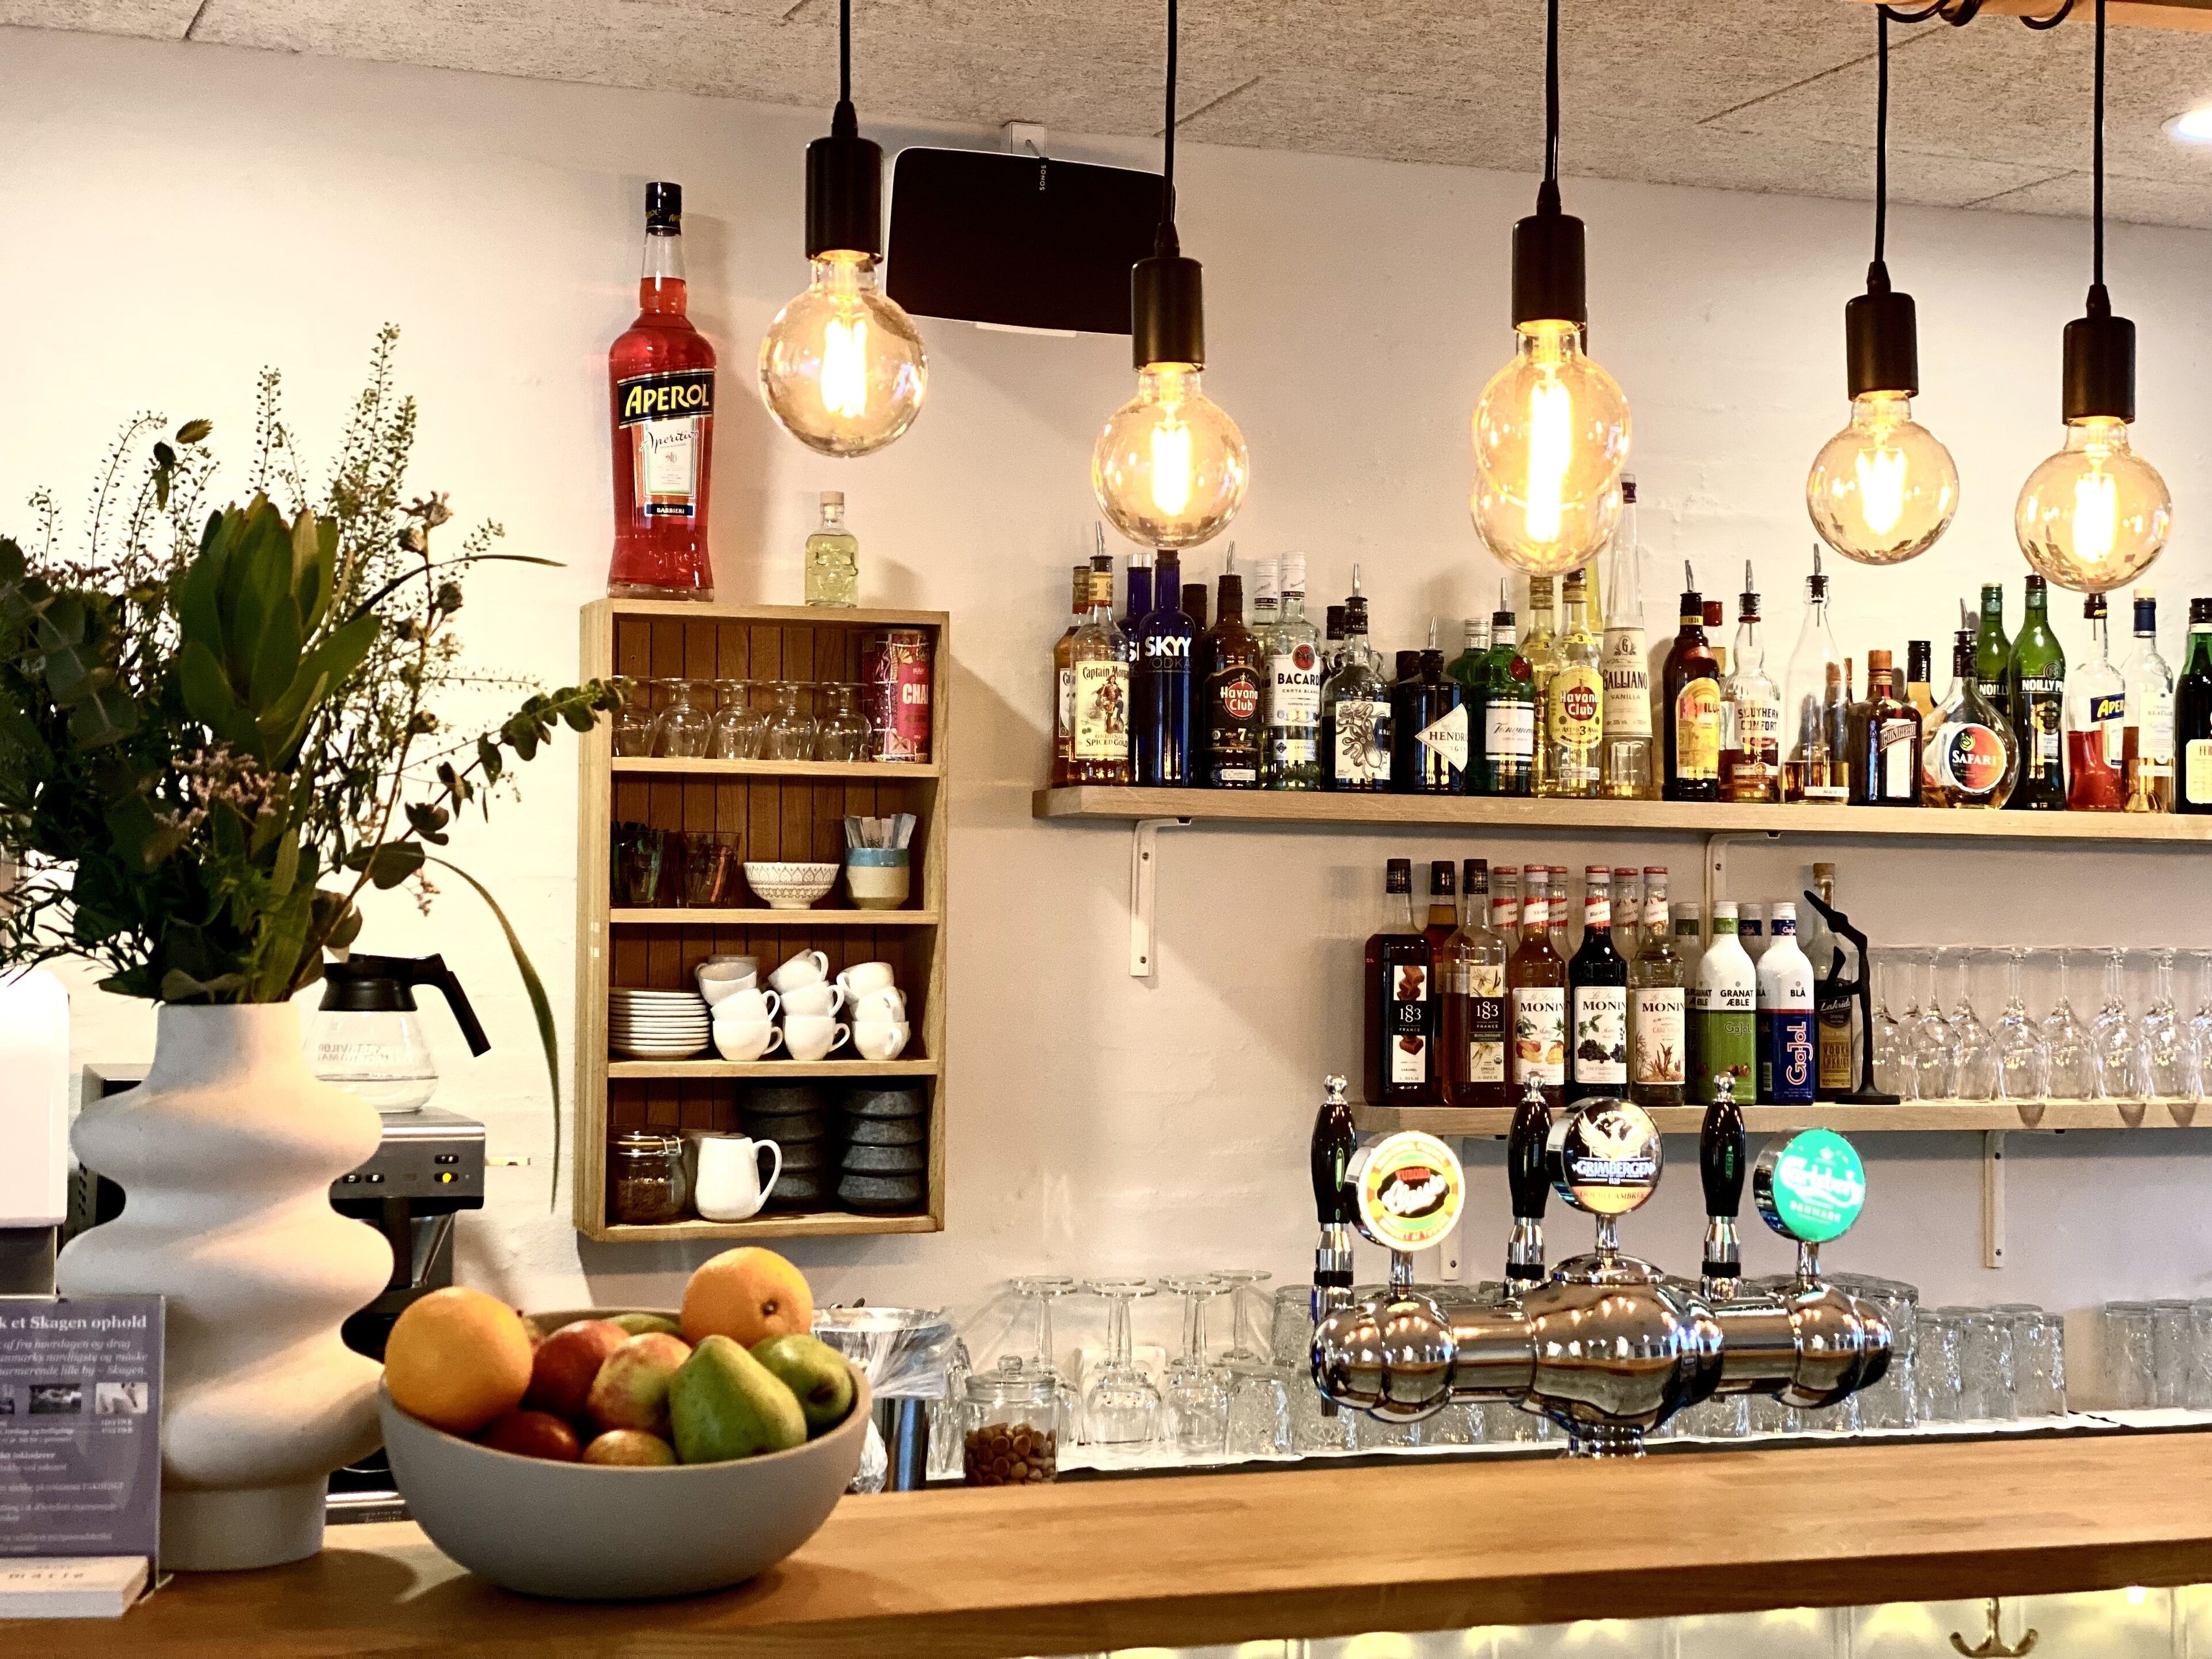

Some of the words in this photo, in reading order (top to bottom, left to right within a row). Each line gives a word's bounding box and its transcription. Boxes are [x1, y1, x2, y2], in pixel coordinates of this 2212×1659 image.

[1039, 164, 1047, 191] SONOS
[625, 384, 709, 417] APEROL
[638, 429, 700, 454] Aperitivo
[1145, 635, 1192, 657] SKYY
[1145, 657, 1192, 669] VODKA
[1082, 665, 1109, 680] Captain
[1603, 670, 1647, 692] GALLIANO
[2022, 679, 2055, 692] NOILLY
[1220, 686, 1258, 699] Havana
[1559, 690, 1599, 703] Havana
[1229, 699, 1253, 711] Club
[1568, 703, 1593, 716] Club
[1738, 707, 1778, 719] SOUTHERN
[1580, 726, 1586, 736] 3
[1741, 720, 1777, 732] COMFORT
[1238, 728, 1247, 741] 7
[1881, 724, 1916, 745] COINTREAU
[1086, 738, 1112, 747] SPICED
[1113, 739, 1128, 747] GOLD
[1952, 750, 1998, 766] SAFARI
[1721, 989, 1753, 997] GRANAT
[1790, 987, 1806, 997] BLÅ
[1820, 997, 1851, 1012] Lakrids
[1576, 1160, 1653, 1175] GRIMBERGEN
[1779, 1155, 1863, 1209] Carlsberg
[1789, 1200, 1842, 1223] DANMARK
[11, 1317, 25, 1328] et
[31, 1315, 86, 1331] Skagen
[91, 1315, 147, 1332] ophold
